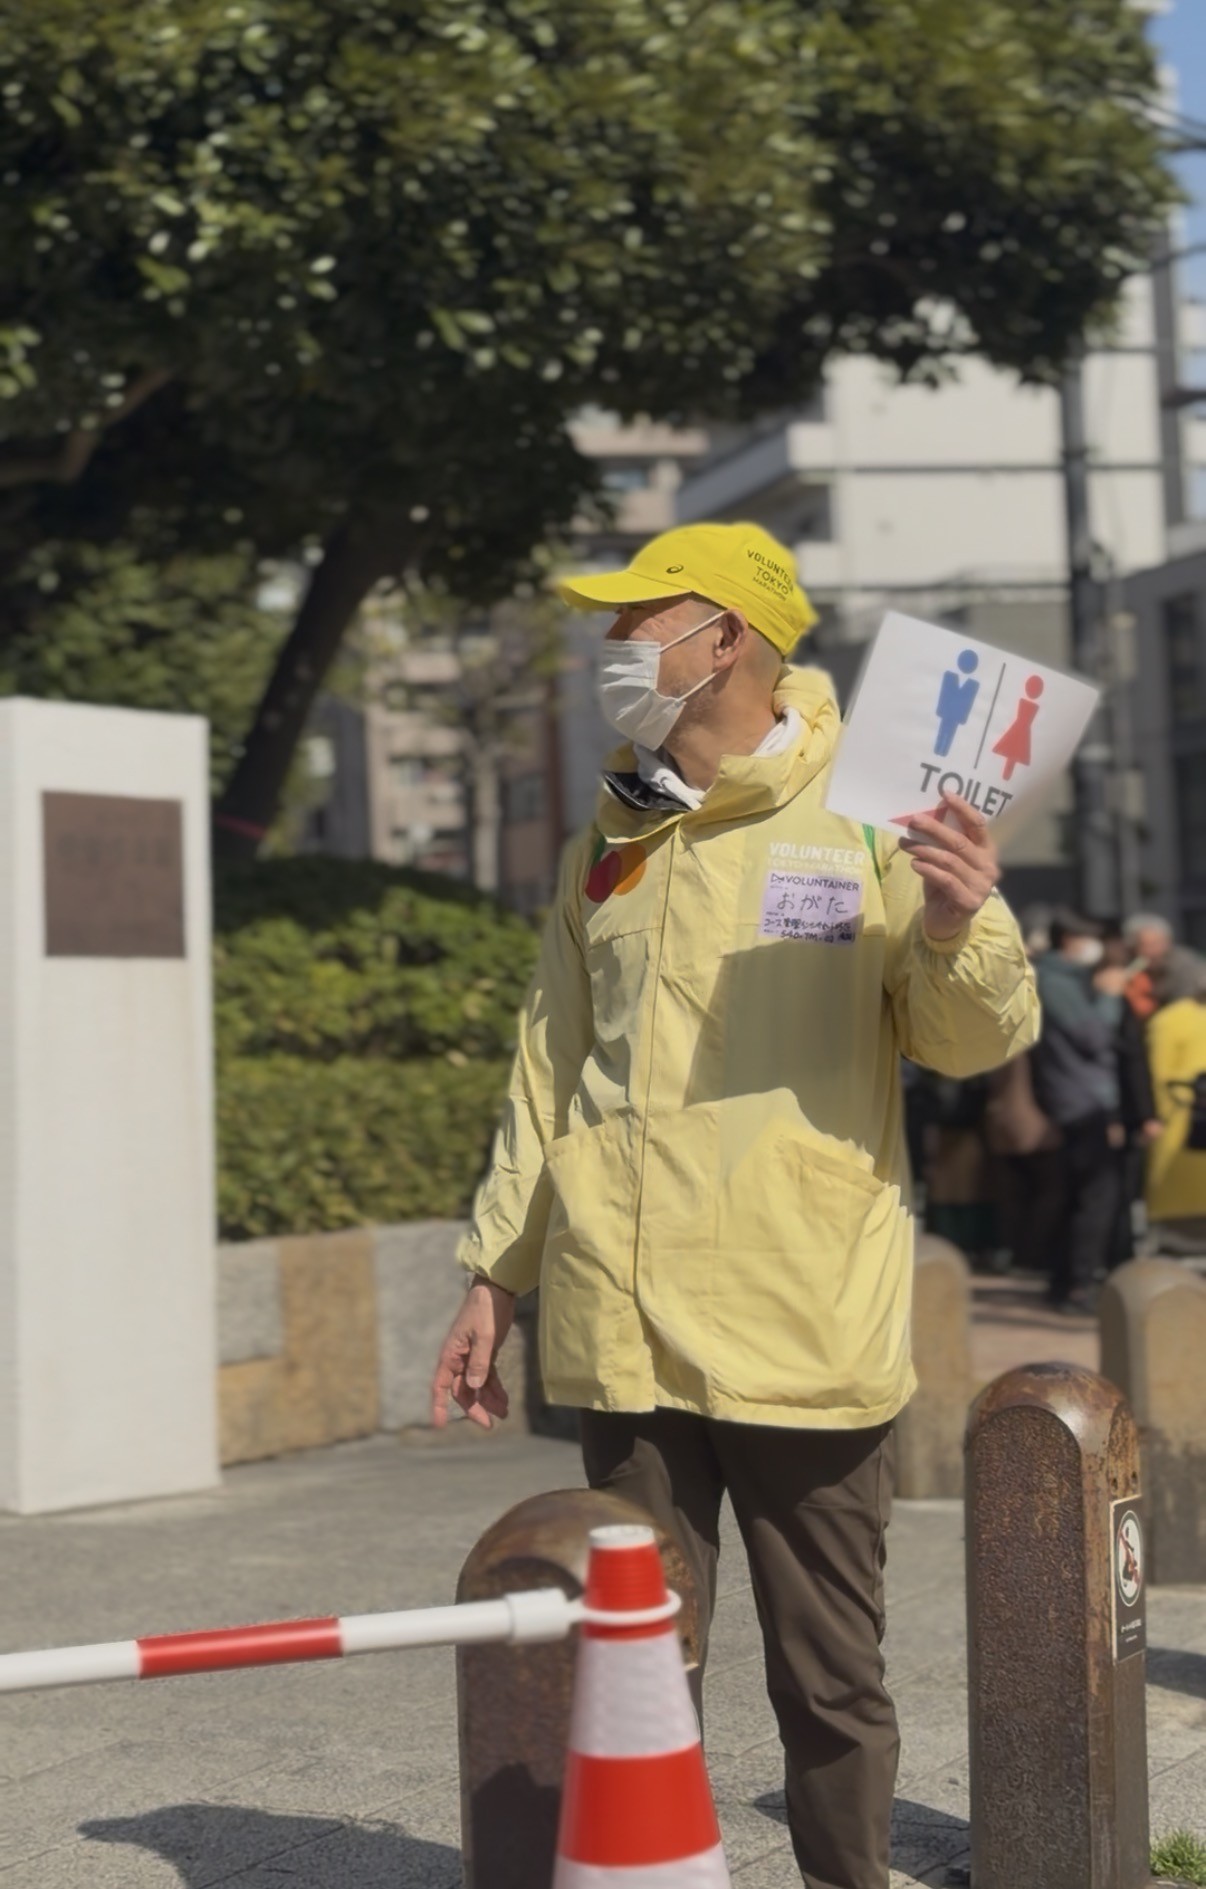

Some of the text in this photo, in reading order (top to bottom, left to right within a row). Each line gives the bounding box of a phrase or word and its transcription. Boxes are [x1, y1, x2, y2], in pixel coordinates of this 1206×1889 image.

[756, 566, 789, 595] TOKYO
[920, 762, 1013, 817] TOILET
[769, 842, 865, 865] VOLUNTEER
[786, 875, 860, 891] VOLUNTAINER
[777, 892, 848, 915] おがた
